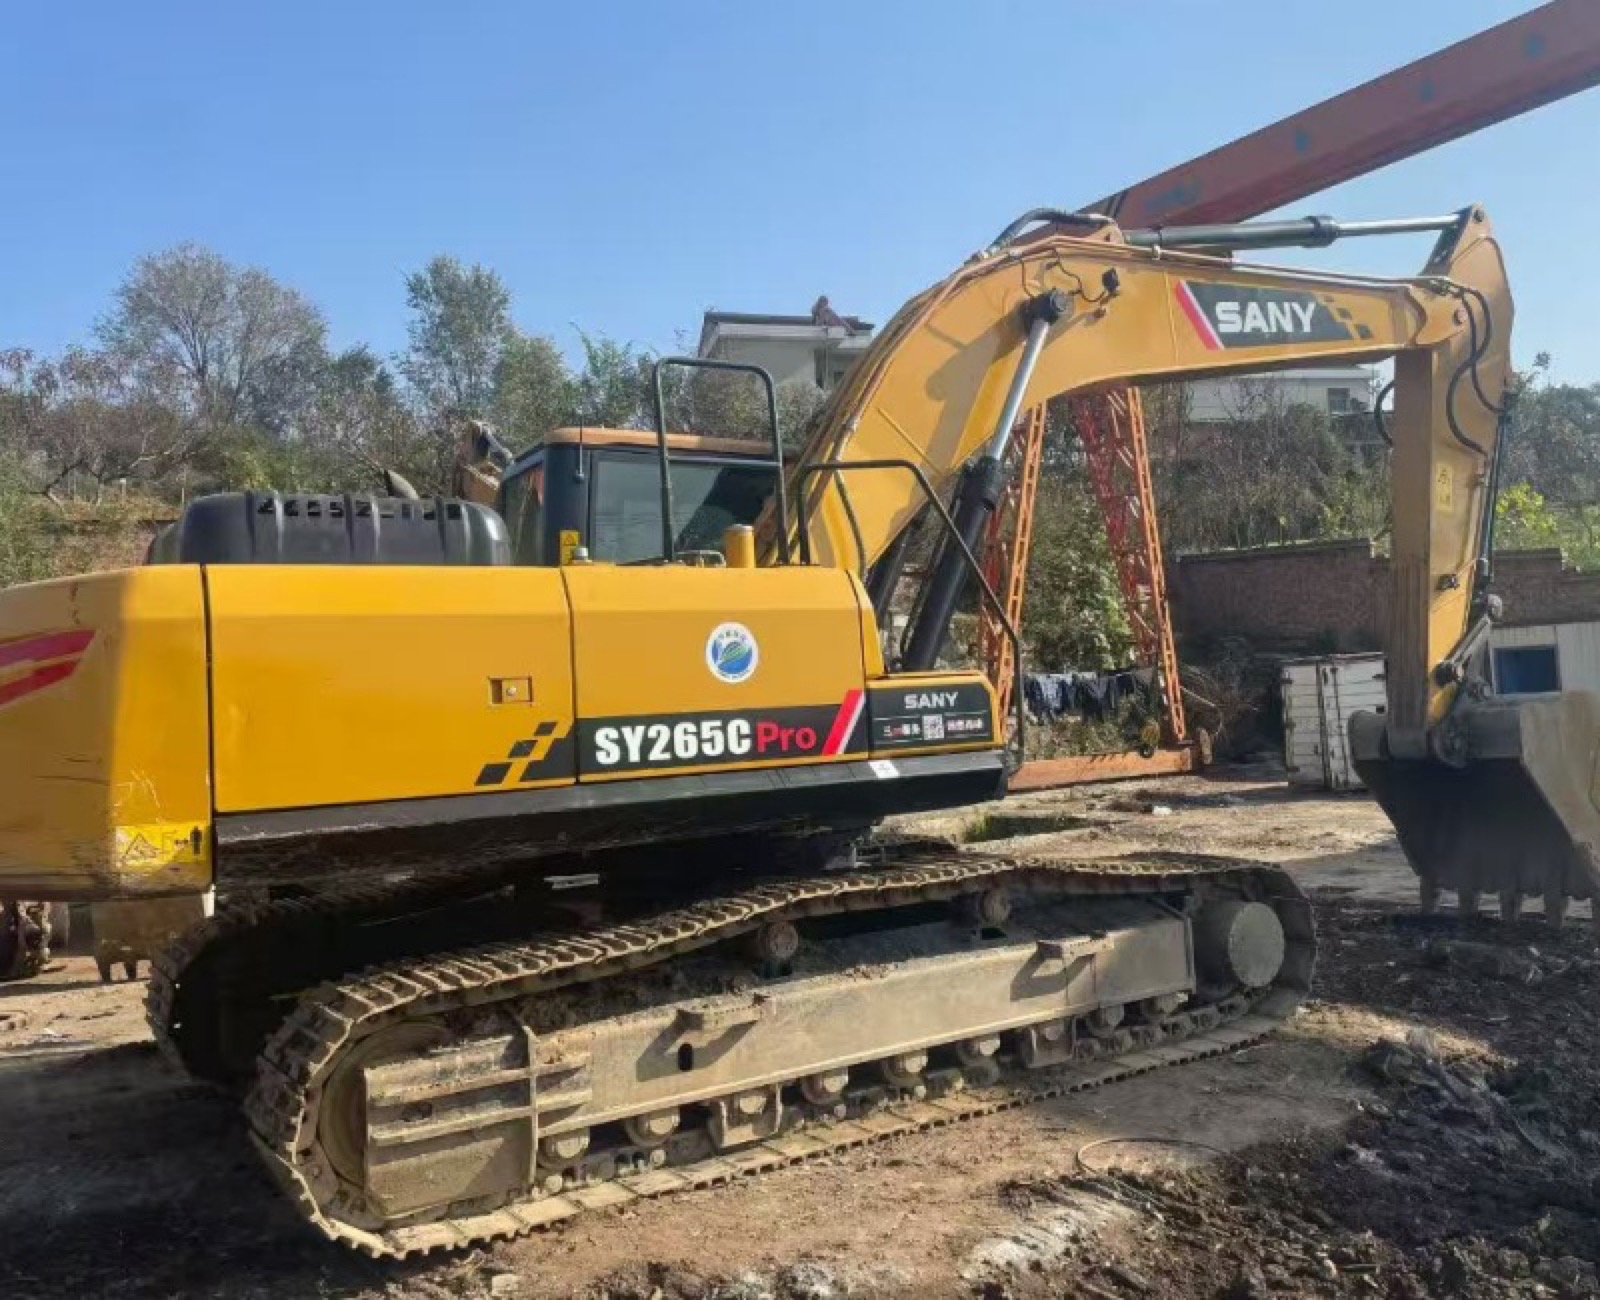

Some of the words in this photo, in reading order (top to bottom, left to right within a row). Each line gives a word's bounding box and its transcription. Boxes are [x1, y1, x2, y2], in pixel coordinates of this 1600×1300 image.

[1215, 301, 1316, 333] SANY
[904, 691, 958, 709] SANY
[594, 719, 752, 765] SY265C
[756, 723, 816, 754] Pro
